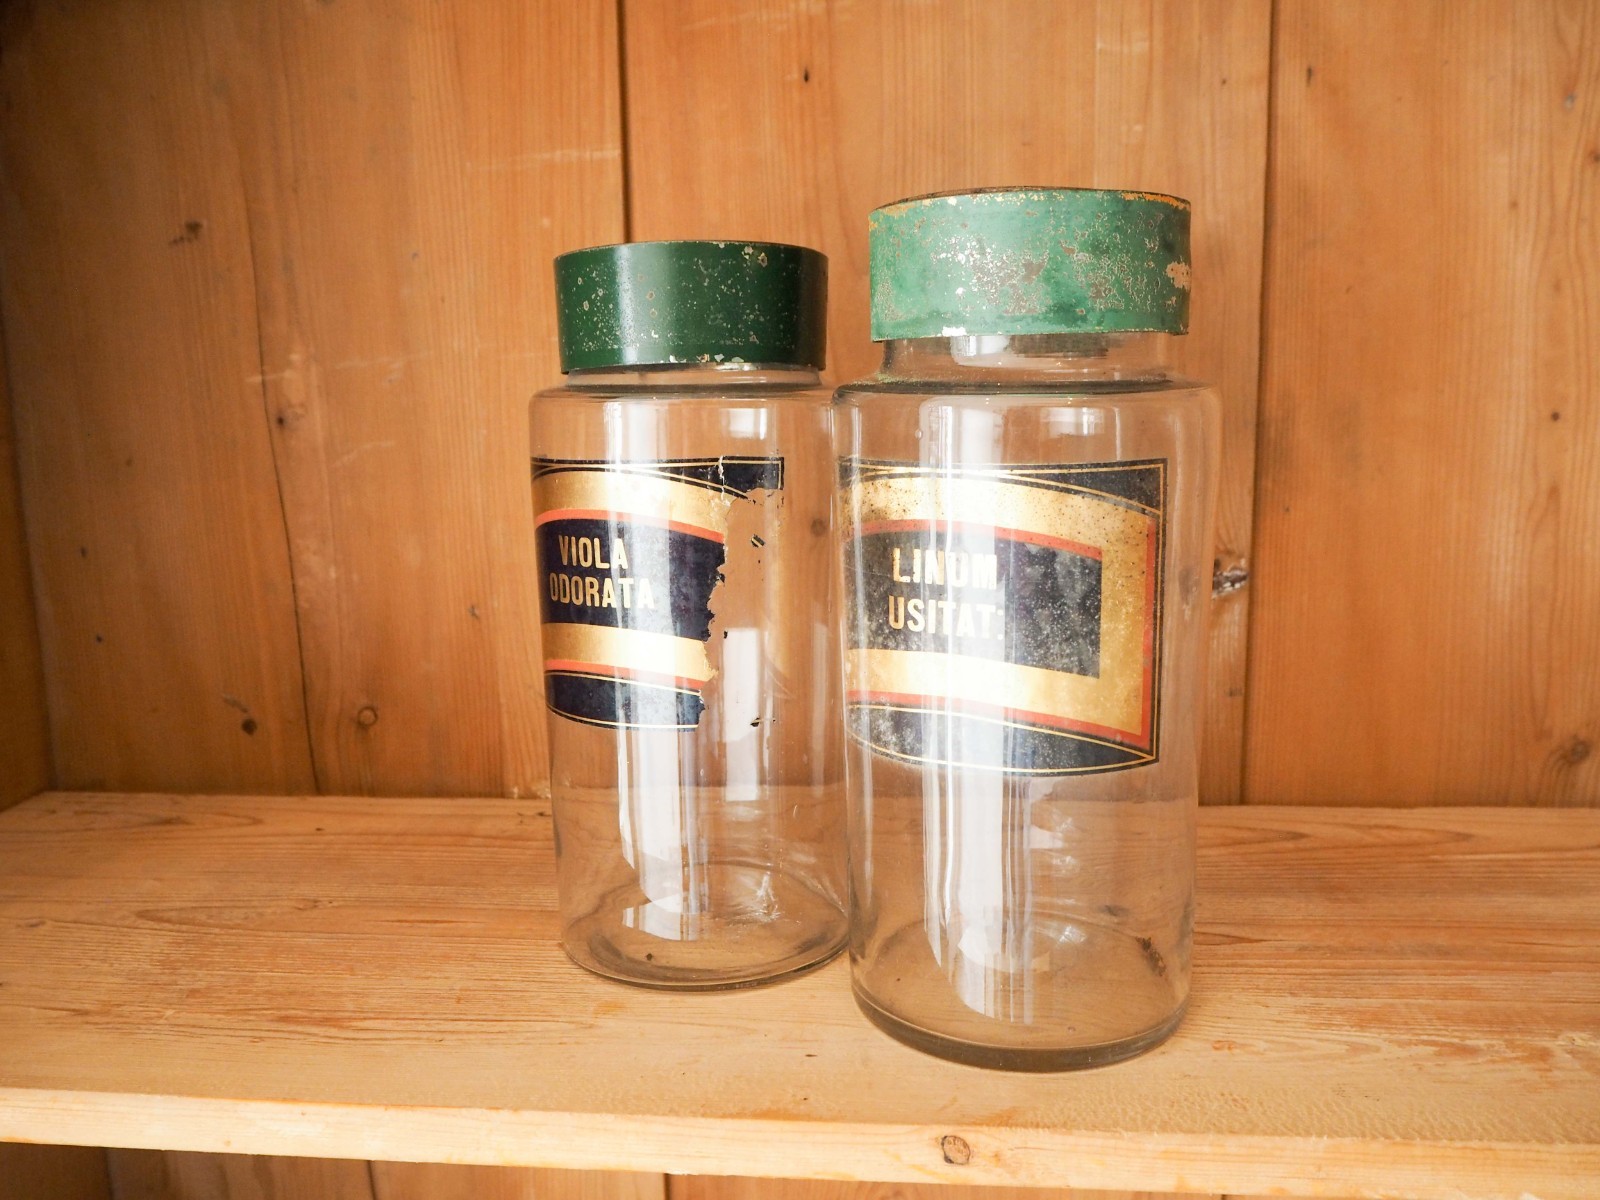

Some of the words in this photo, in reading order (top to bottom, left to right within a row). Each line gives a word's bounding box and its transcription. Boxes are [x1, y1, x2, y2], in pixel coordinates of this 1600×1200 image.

[558, 534, 628, 569] VIOLA
[892, 547, 998, 591] LINUM
[549, 572, 655, 609] ODORATA
